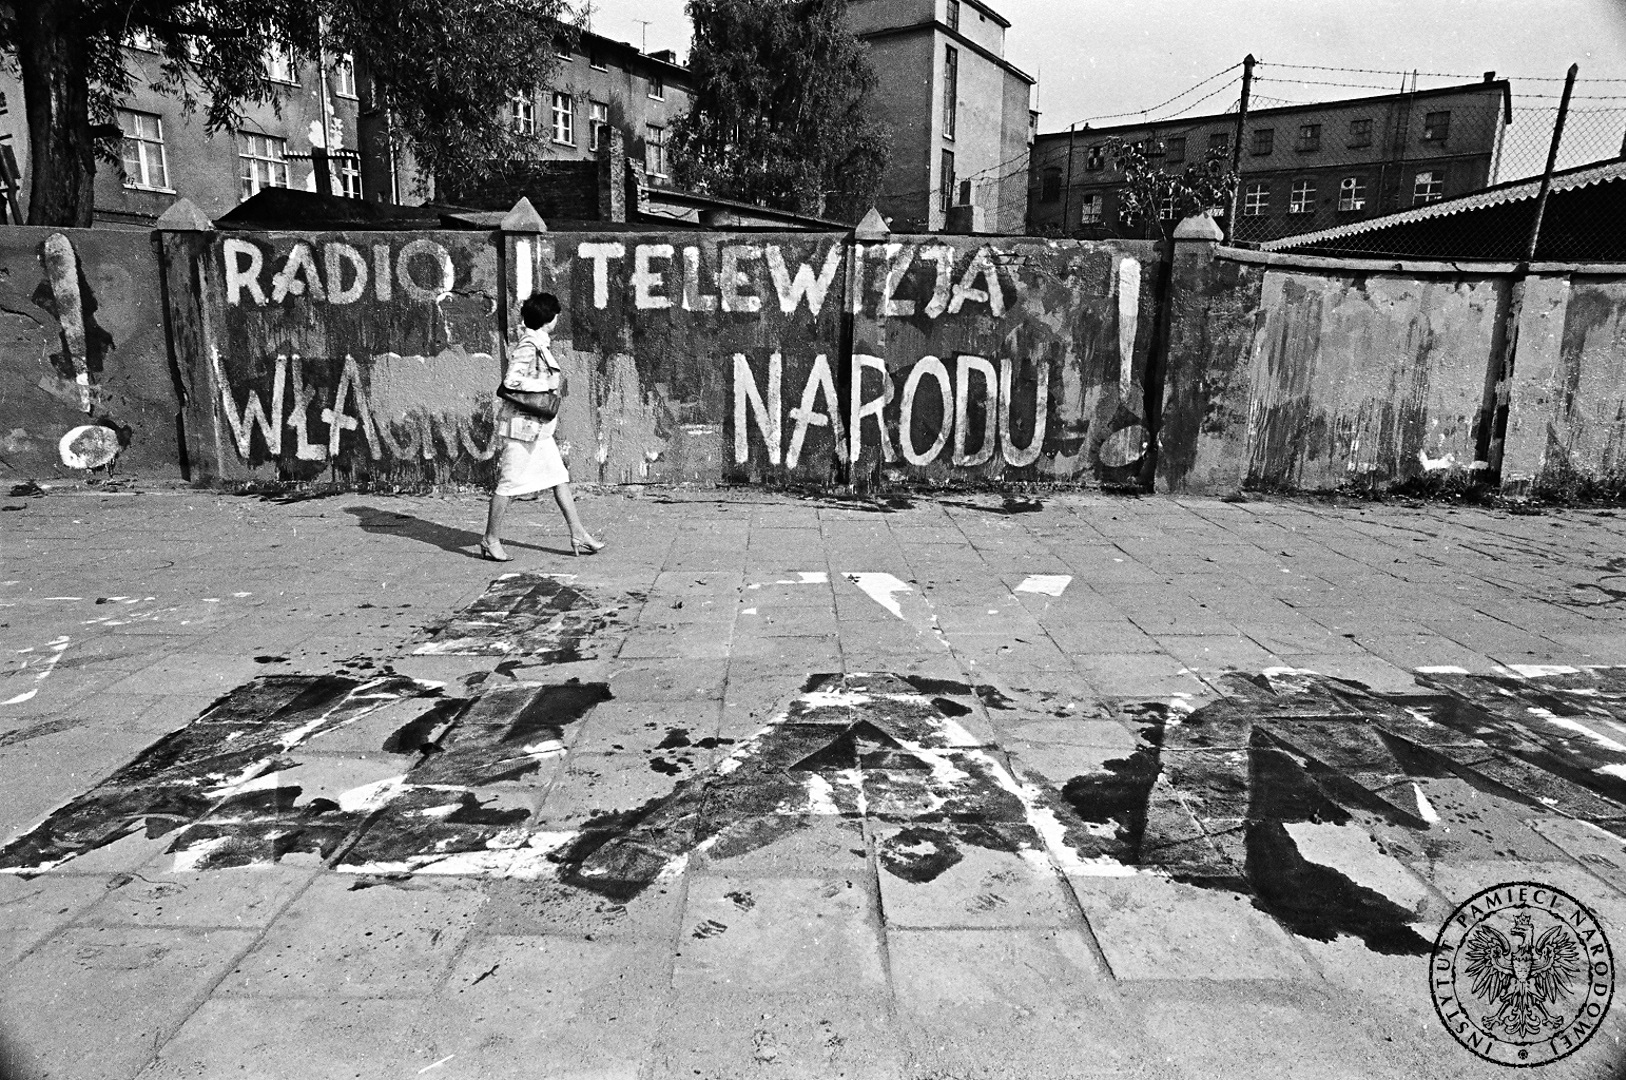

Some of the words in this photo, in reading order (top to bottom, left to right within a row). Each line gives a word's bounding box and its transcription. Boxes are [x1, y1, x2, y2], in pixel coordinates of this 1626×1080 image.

[222, 238, 454, 306] RADIO
[515, 240, 533, 303] I
[577, 242, 1006, 319] TELEWIZJA
[733, 350, 1048, 469] NARODU
